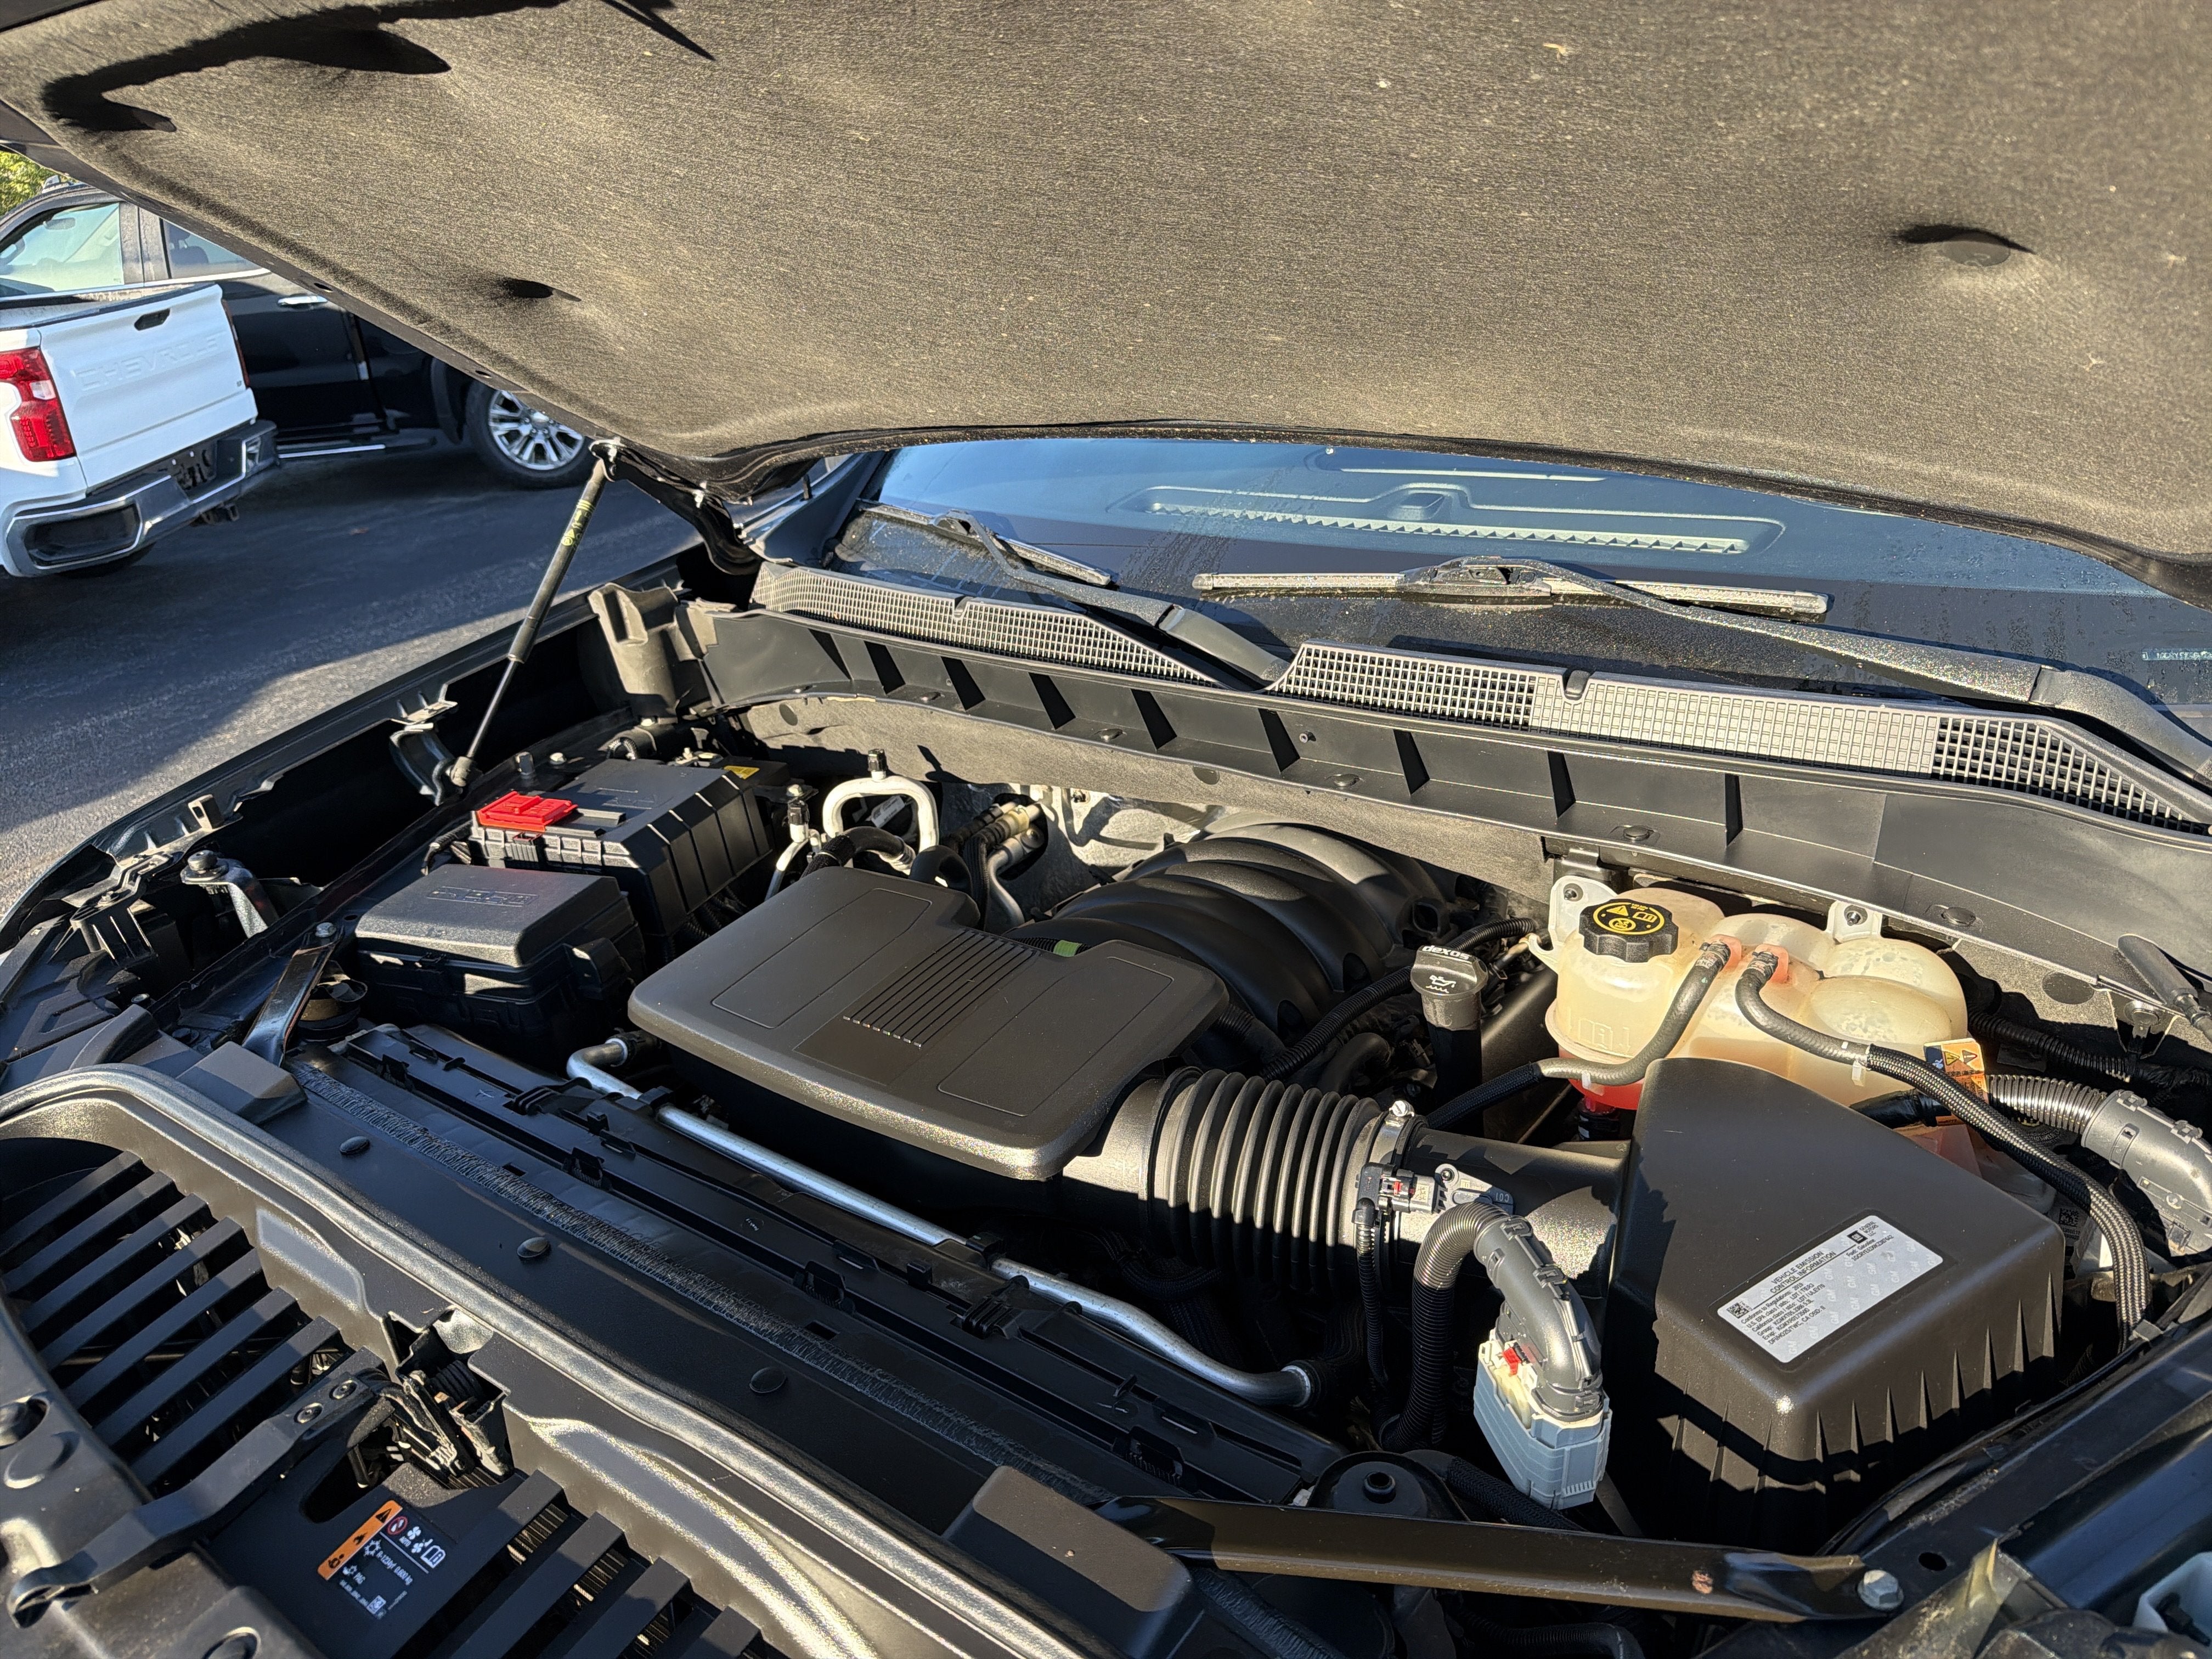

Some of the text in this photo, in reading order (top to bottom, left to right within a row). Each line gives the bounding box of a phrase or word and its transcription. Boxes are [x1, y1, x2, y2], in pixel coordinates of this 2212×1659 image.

[1422, 945, 1470, 960] dexos
[1857, 1238, 1876, 1250] Gasoline
[1769, 1251, 1836, 1293] CONTROL INFORMATION
[1770, 1250, 1824, 1284] VEHICLE EMISSION
[1740, 1309, 1763, 1324] Conforms
[1765, 1290, 1792, 1307] Regulations:
[1792, 1282, 1803, 1290] 2019
[1751, 1317, 1773, 1332] California
[1772, 1310, 1784, 1319] class
[1796, 1294, 1807, 1302] LDT
[1765, 1307, 1778, 1316] class
[1808, 1308, 1822, 1317] OBD:
[1757, 1325, 1774, 1336] Group:
[1762, 1330, 1776, 1340] Evap:
